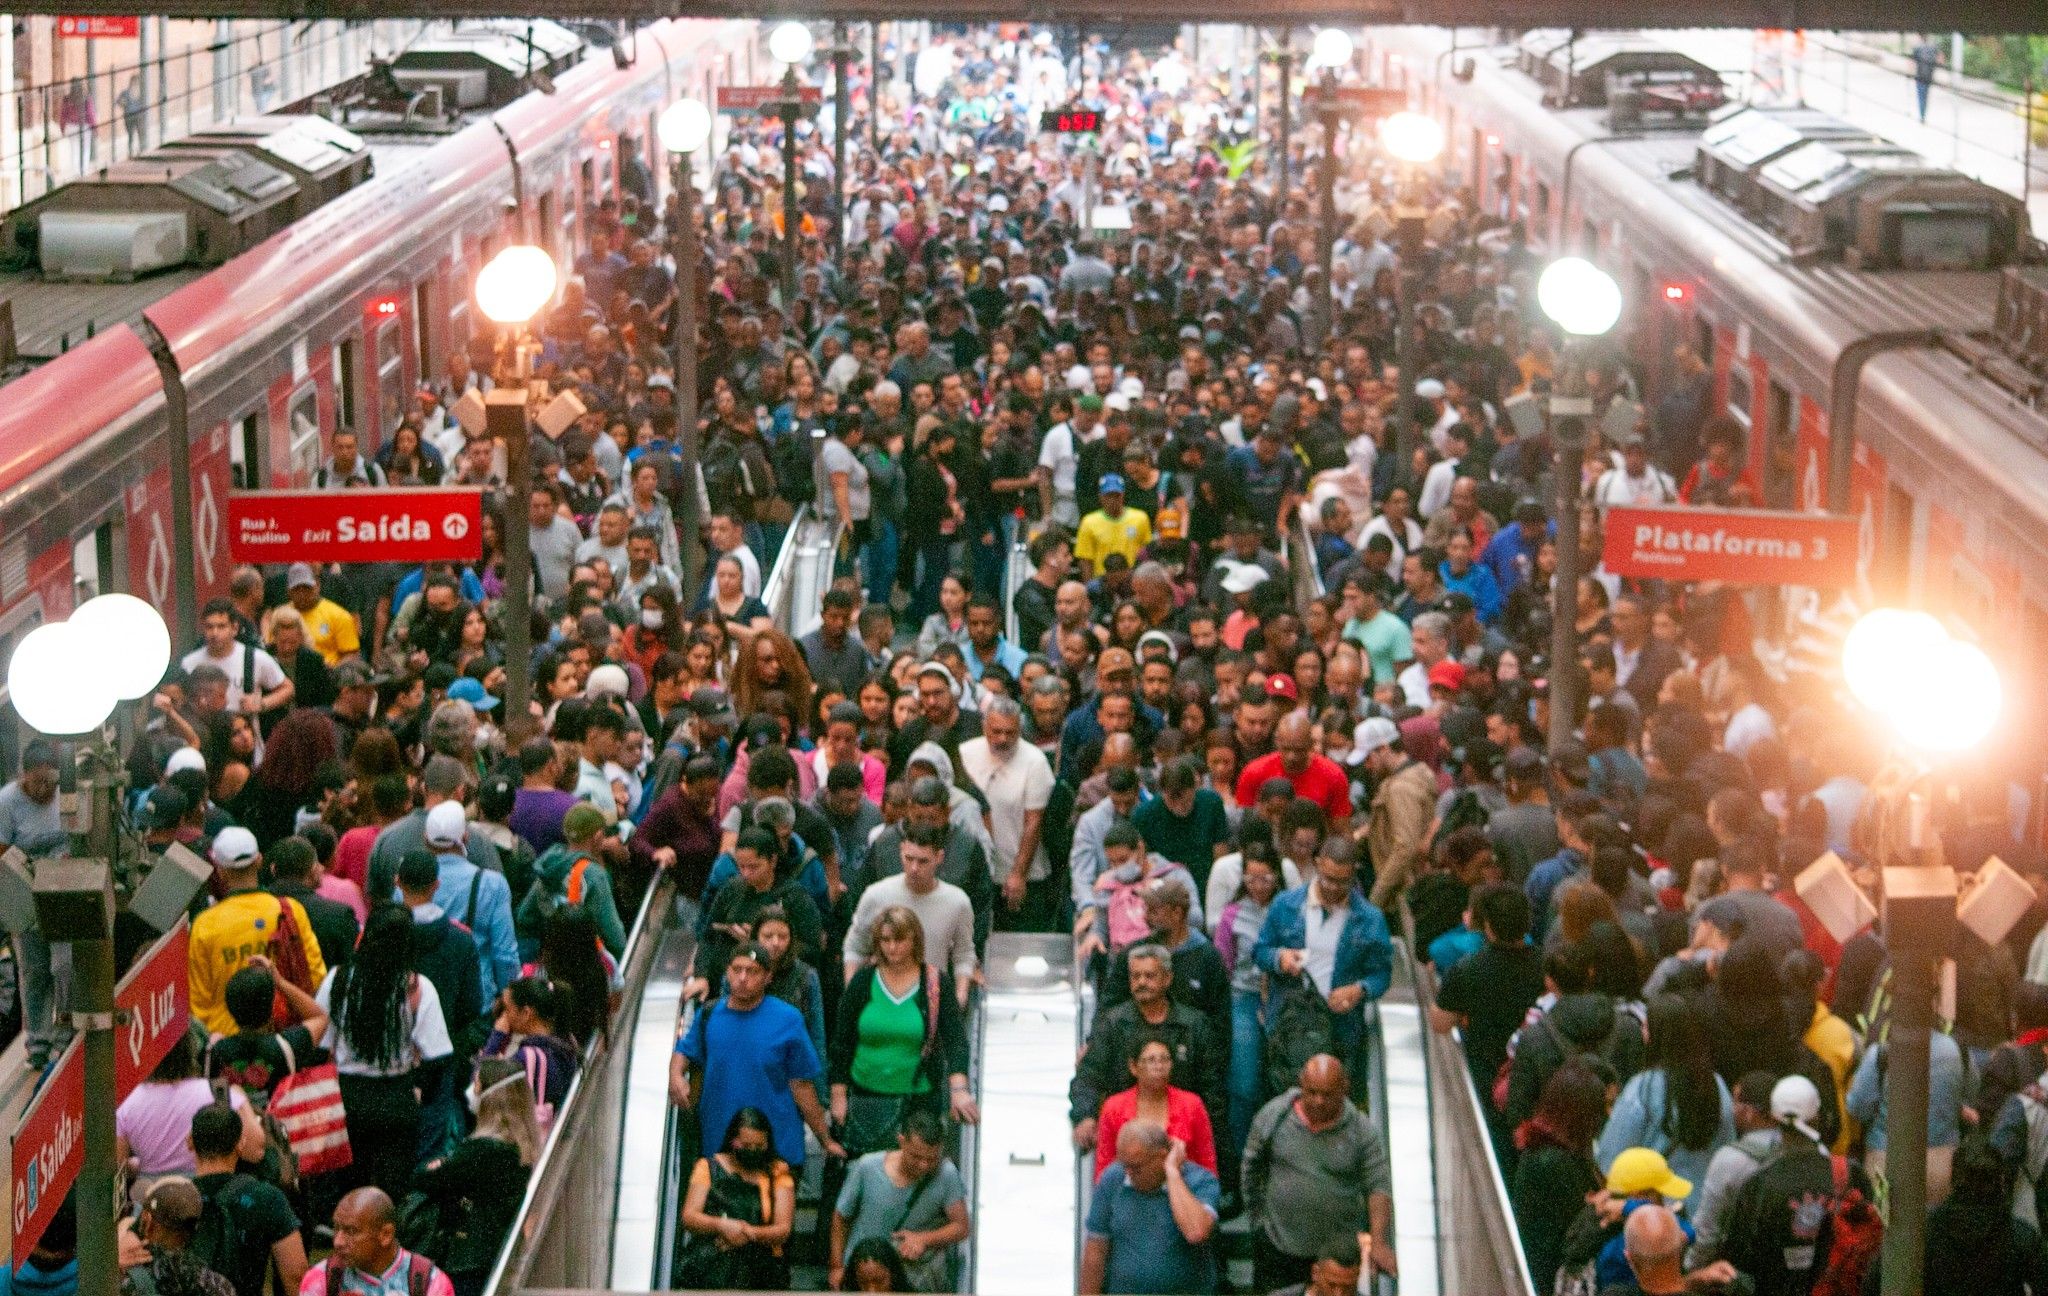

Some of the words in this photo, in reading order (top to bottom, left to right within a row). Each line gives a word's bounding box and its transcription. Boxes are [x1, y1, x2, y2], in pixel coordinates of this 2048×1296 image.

[240, 517, 266, 530] Rua
[240, 531, 291, 544] Paulino
[303, 528, 331, 544] Exit
[336, 513, 431, 543] Saída
[1634, 525, 1801, 558] Plataforma
[1811, 537, 1830, 560] 3
[150, 980, 176, 1040] Luz
[40, 1110, 73, 1196] Saída
